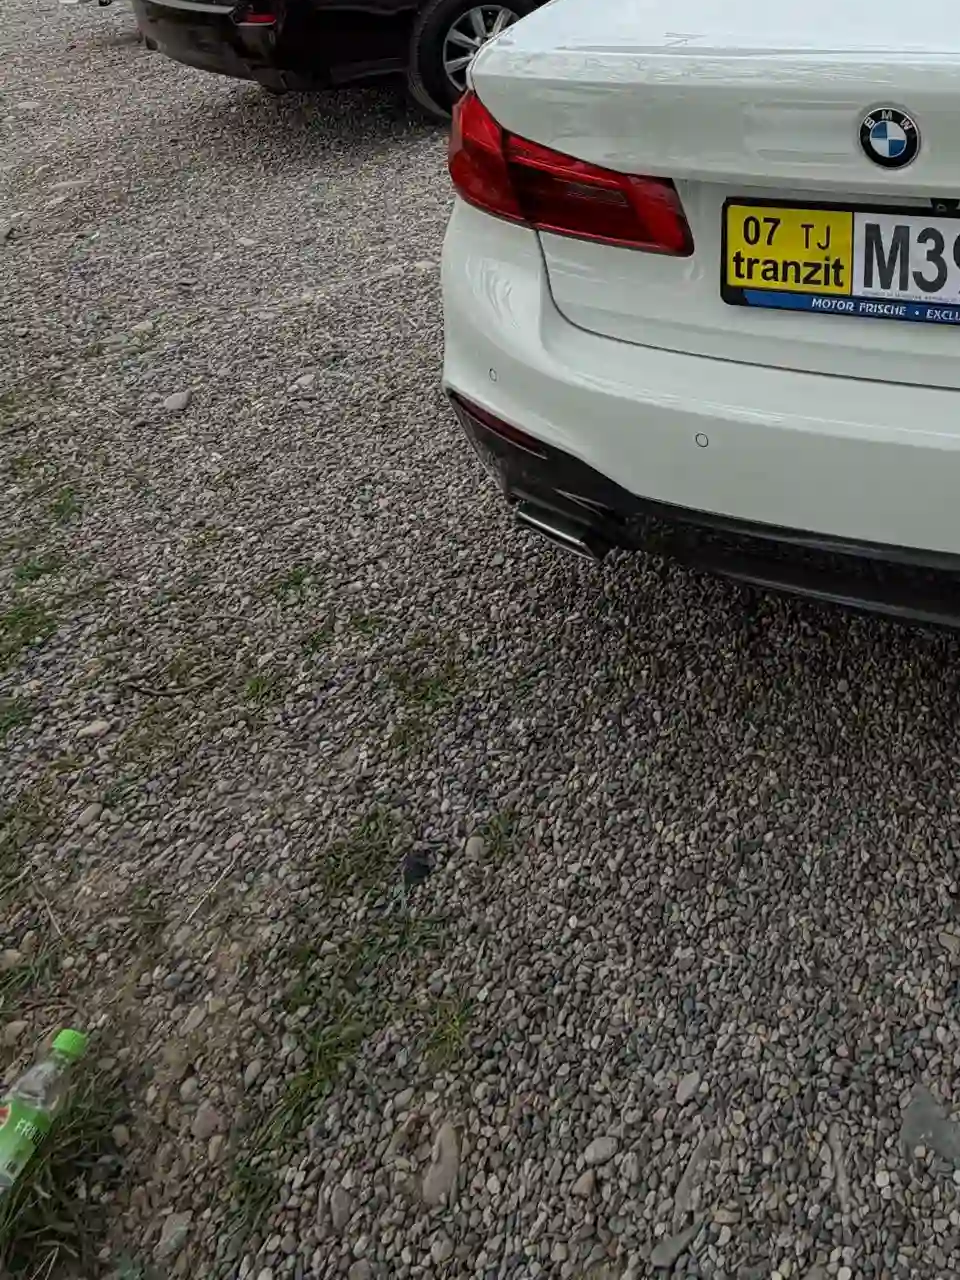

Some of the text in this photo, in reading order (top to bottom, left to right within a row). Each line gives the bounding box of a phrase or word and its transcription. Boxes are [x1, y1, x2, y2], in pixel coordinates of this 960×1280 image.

[864, 110, 913, 130] BMW
[743, 215, 831, 250] 07 TJ
[733, 251, 844, 288] tranzit
[811, 298, 855, 312] MOTOR
[859, 302, 907, 316] FRISCHE
